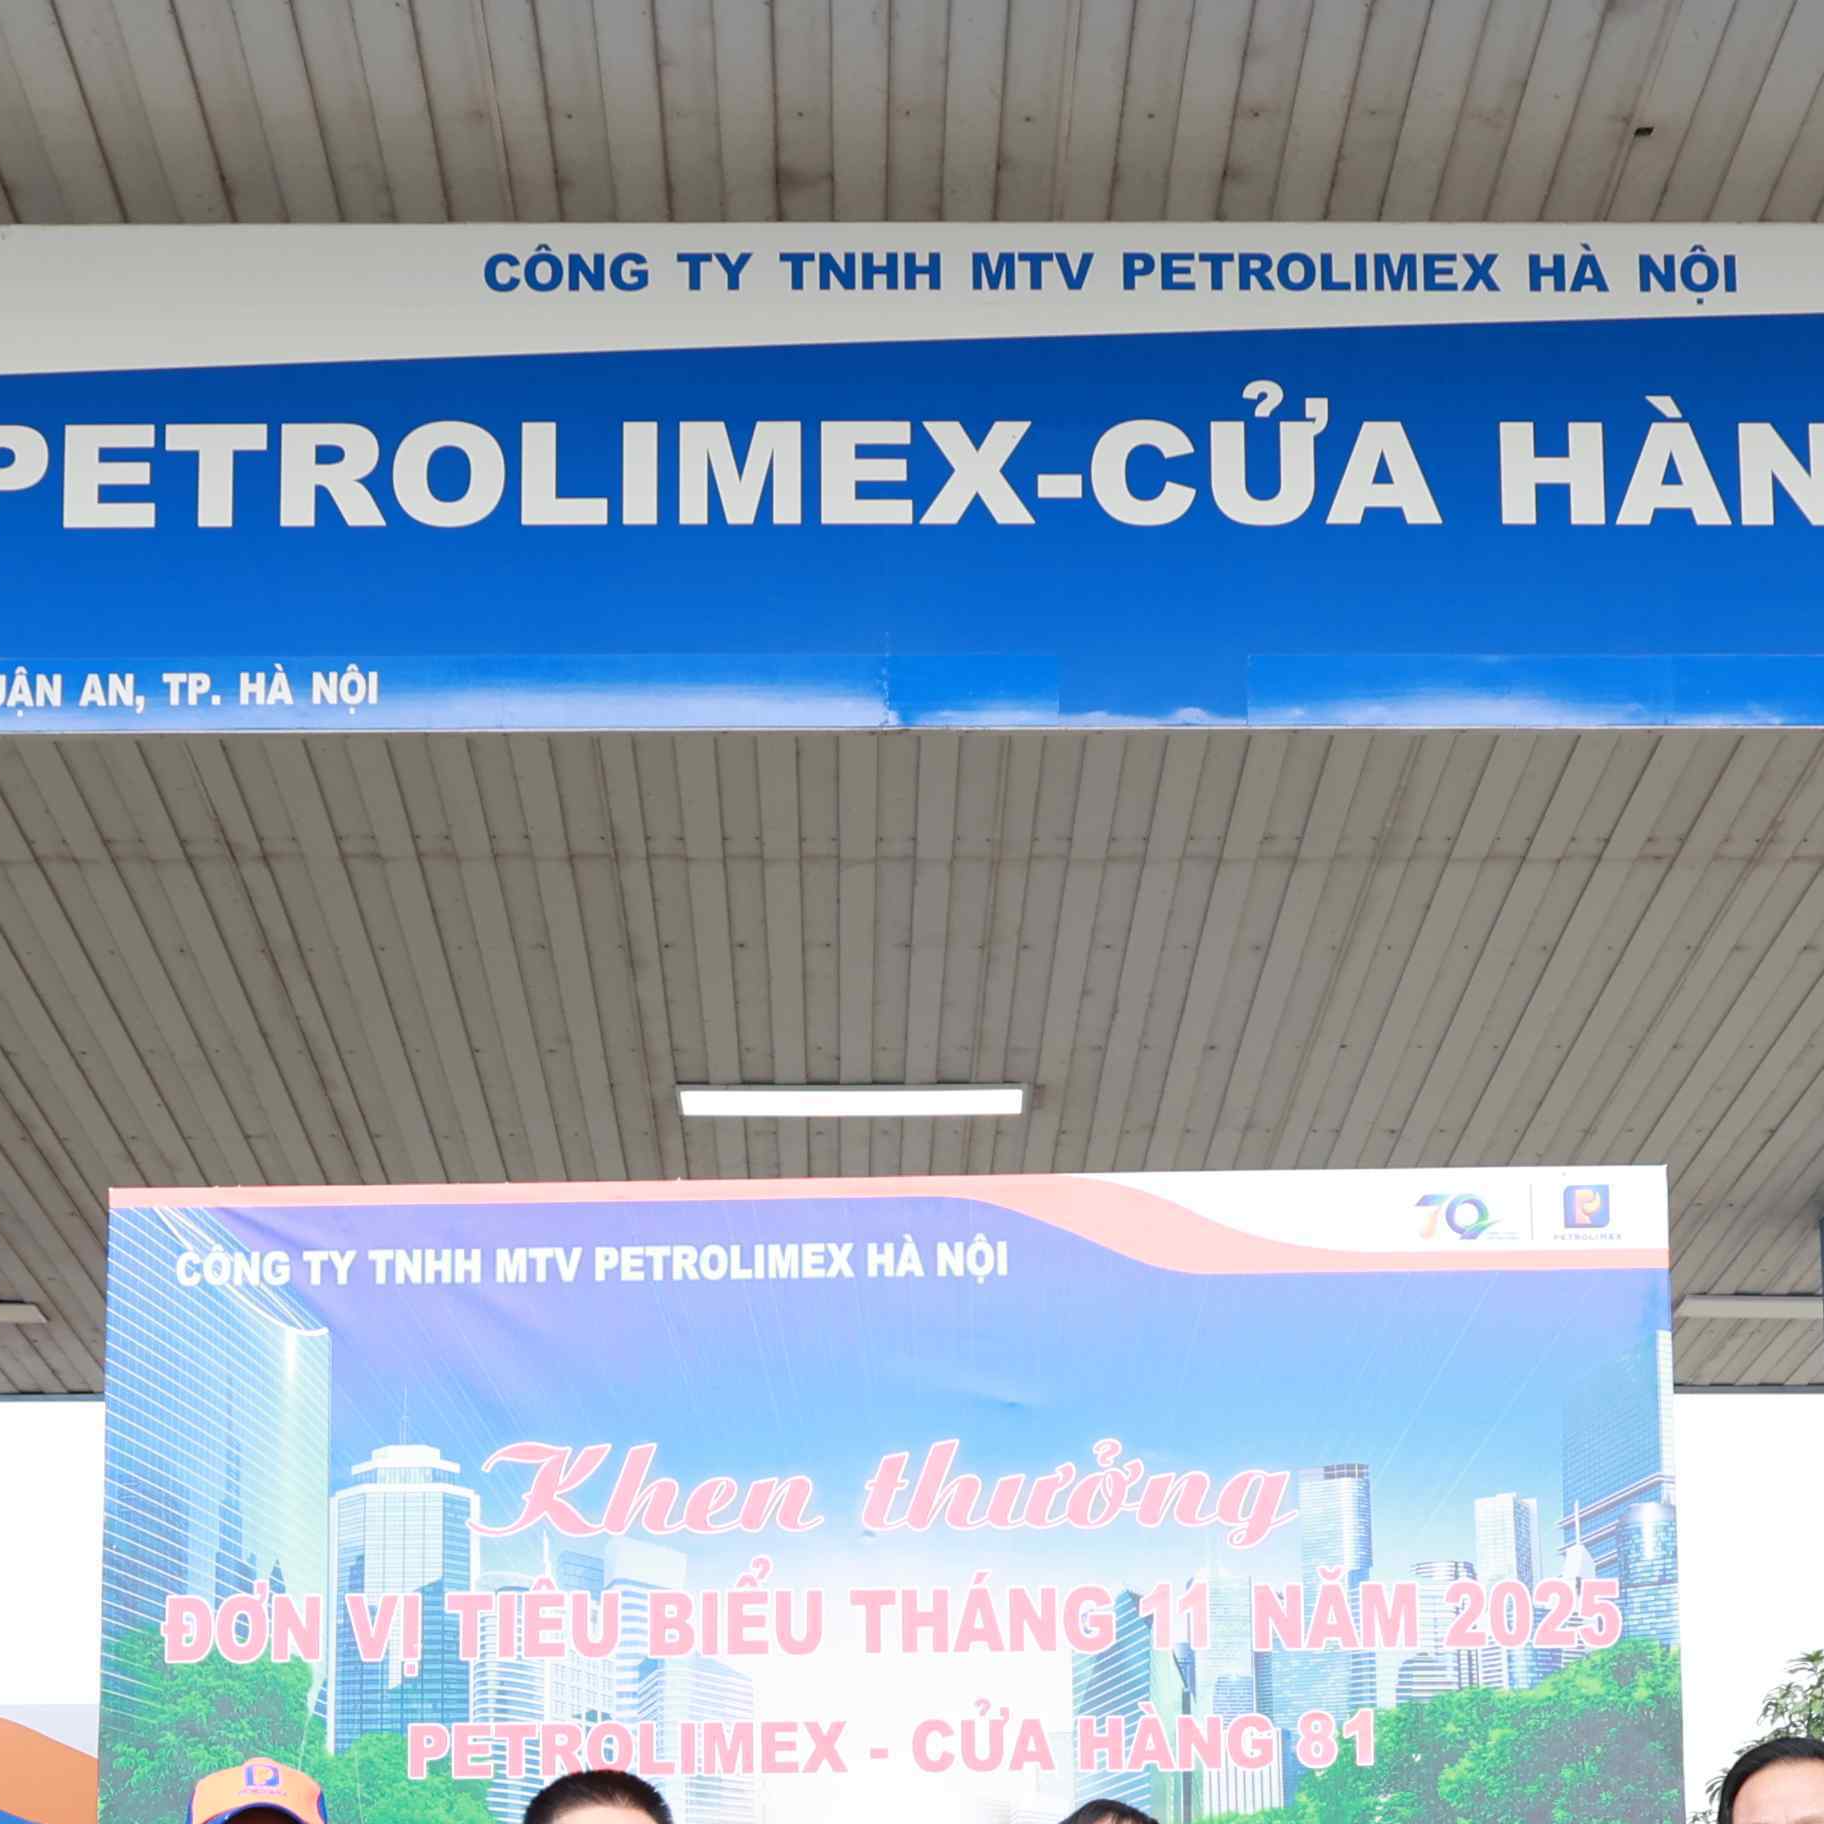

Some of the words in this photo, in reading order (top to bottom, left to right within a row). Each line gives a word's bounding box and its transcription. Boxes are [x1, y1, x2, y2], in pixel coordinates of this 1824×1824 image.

[484, 244, 649, 293] CÔNG
[677, 252, 753, 291] TY
[780, 252, 941, 290] TNHH
[973, 252, 1094, 290] MTV
[1122, 252, 1500, 292] PETROLIMEX
[1529, 243, 1609, 293] HÀ
[1639, 244, 1737, 305] NỘI
[79, 673, 145, 714] AN,
[162, 672, 221, 707] TP.
[240, 663, 293, 706] HÀ
[311, 663, 379, 714] NỘI
[176, 1243, 291, 1288] CÔNG
[303, 1250, 358, 1286] TY
[368, 1248, 483, 1285] TNHH
[495, 1246, 583, 1283] MTV
[594, 1242, 851, 1282] PETROLIMEX
[866, 1233, 924, 1278] HÀ
[936, 1233, 1009, 1286] NỘI
[467, 1441, 824, 1537] Khen
[862, 1438, 1297, 1548] thưởng
[161, 1581, 323, 1663] ĐƠN
[345, 1592, 422, 1677] VỊ
[446, 1576, 621, 1661] TIÊU
[648, 1556, 824, 1659] BIỂU
[850, 1572, 1117, 1653] THÁNG
[1139, 1579, 1212, 1651] 11
[1252, 1566, 1419, 1652] NĂM
[1443, 1578, 1623, 1650] 2025
[407, 1719, 848, 1779] PETROLIMEX
[912, 1699, 1055, 1773] CỬA
[1077, 1703, 1275, 1773] HÀNG
[1296, 1708, 1376, 1768] 81
